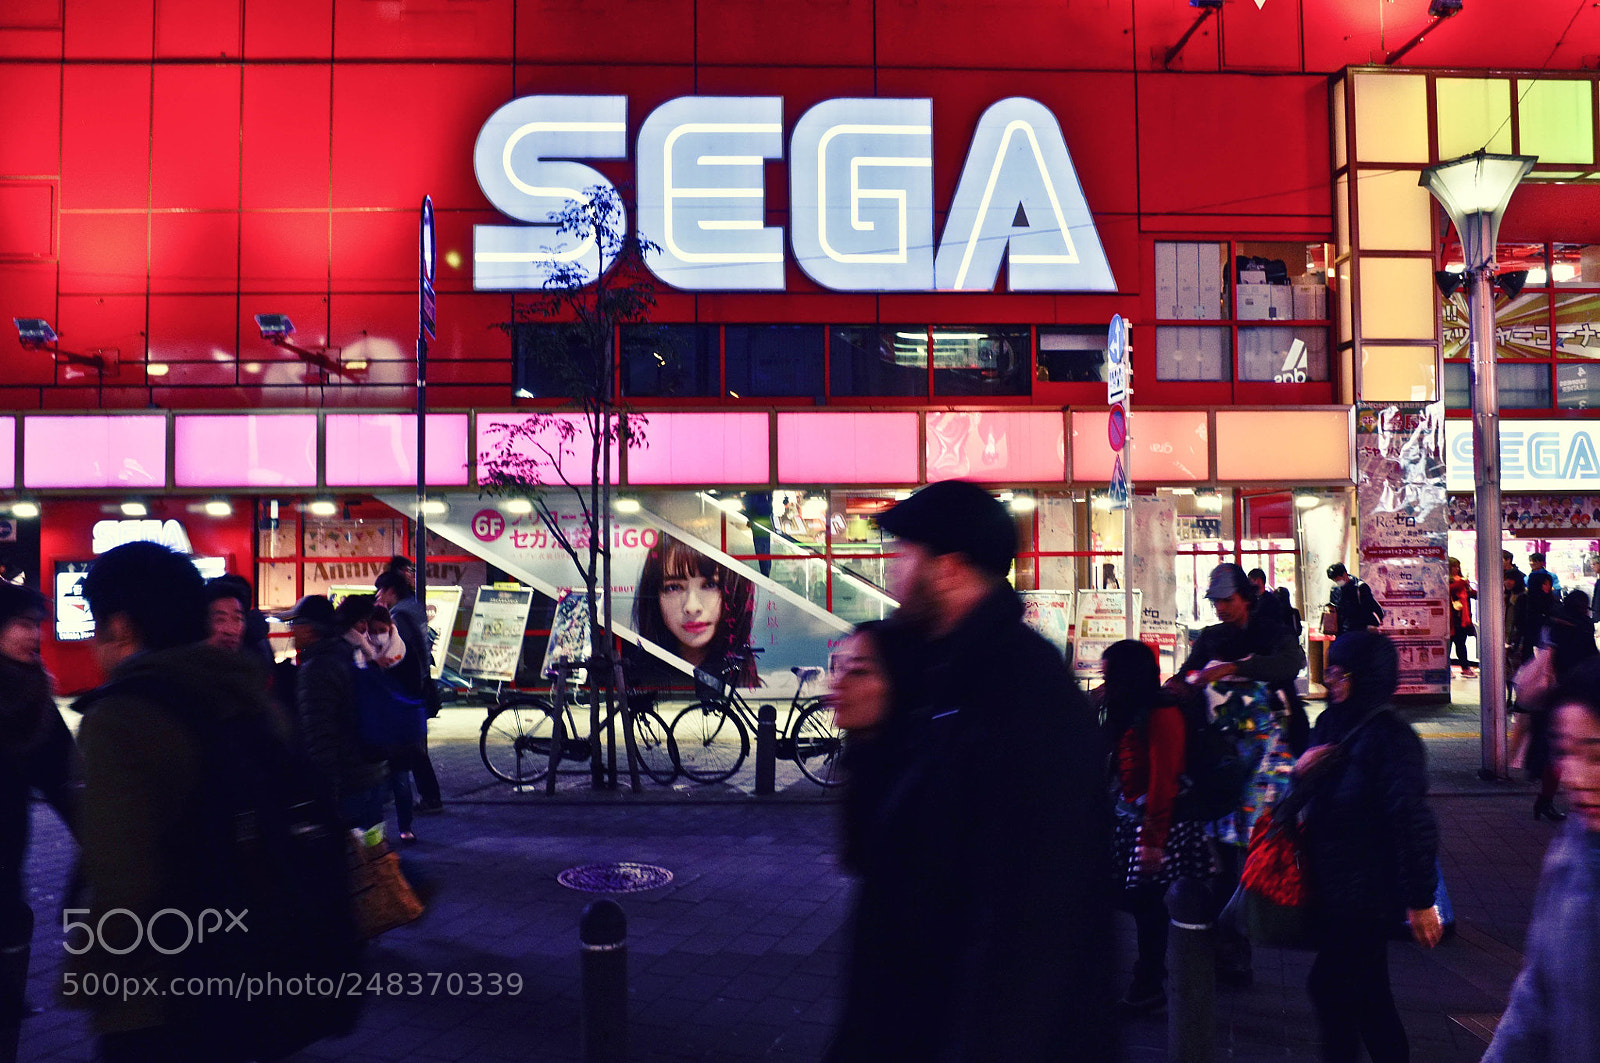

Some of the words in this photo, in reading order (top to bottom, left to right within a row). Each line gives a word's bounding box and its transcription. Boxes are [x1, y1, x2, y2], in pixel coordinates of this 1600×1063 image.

[473, 95, 1118, 292] SEGA
[1452, 431, 1600, 480] SEGA
[92, 519, 193, 553] SEGA
[475, 515, 502, 537] 6F
[314, 562, 467, 582] Annivary
